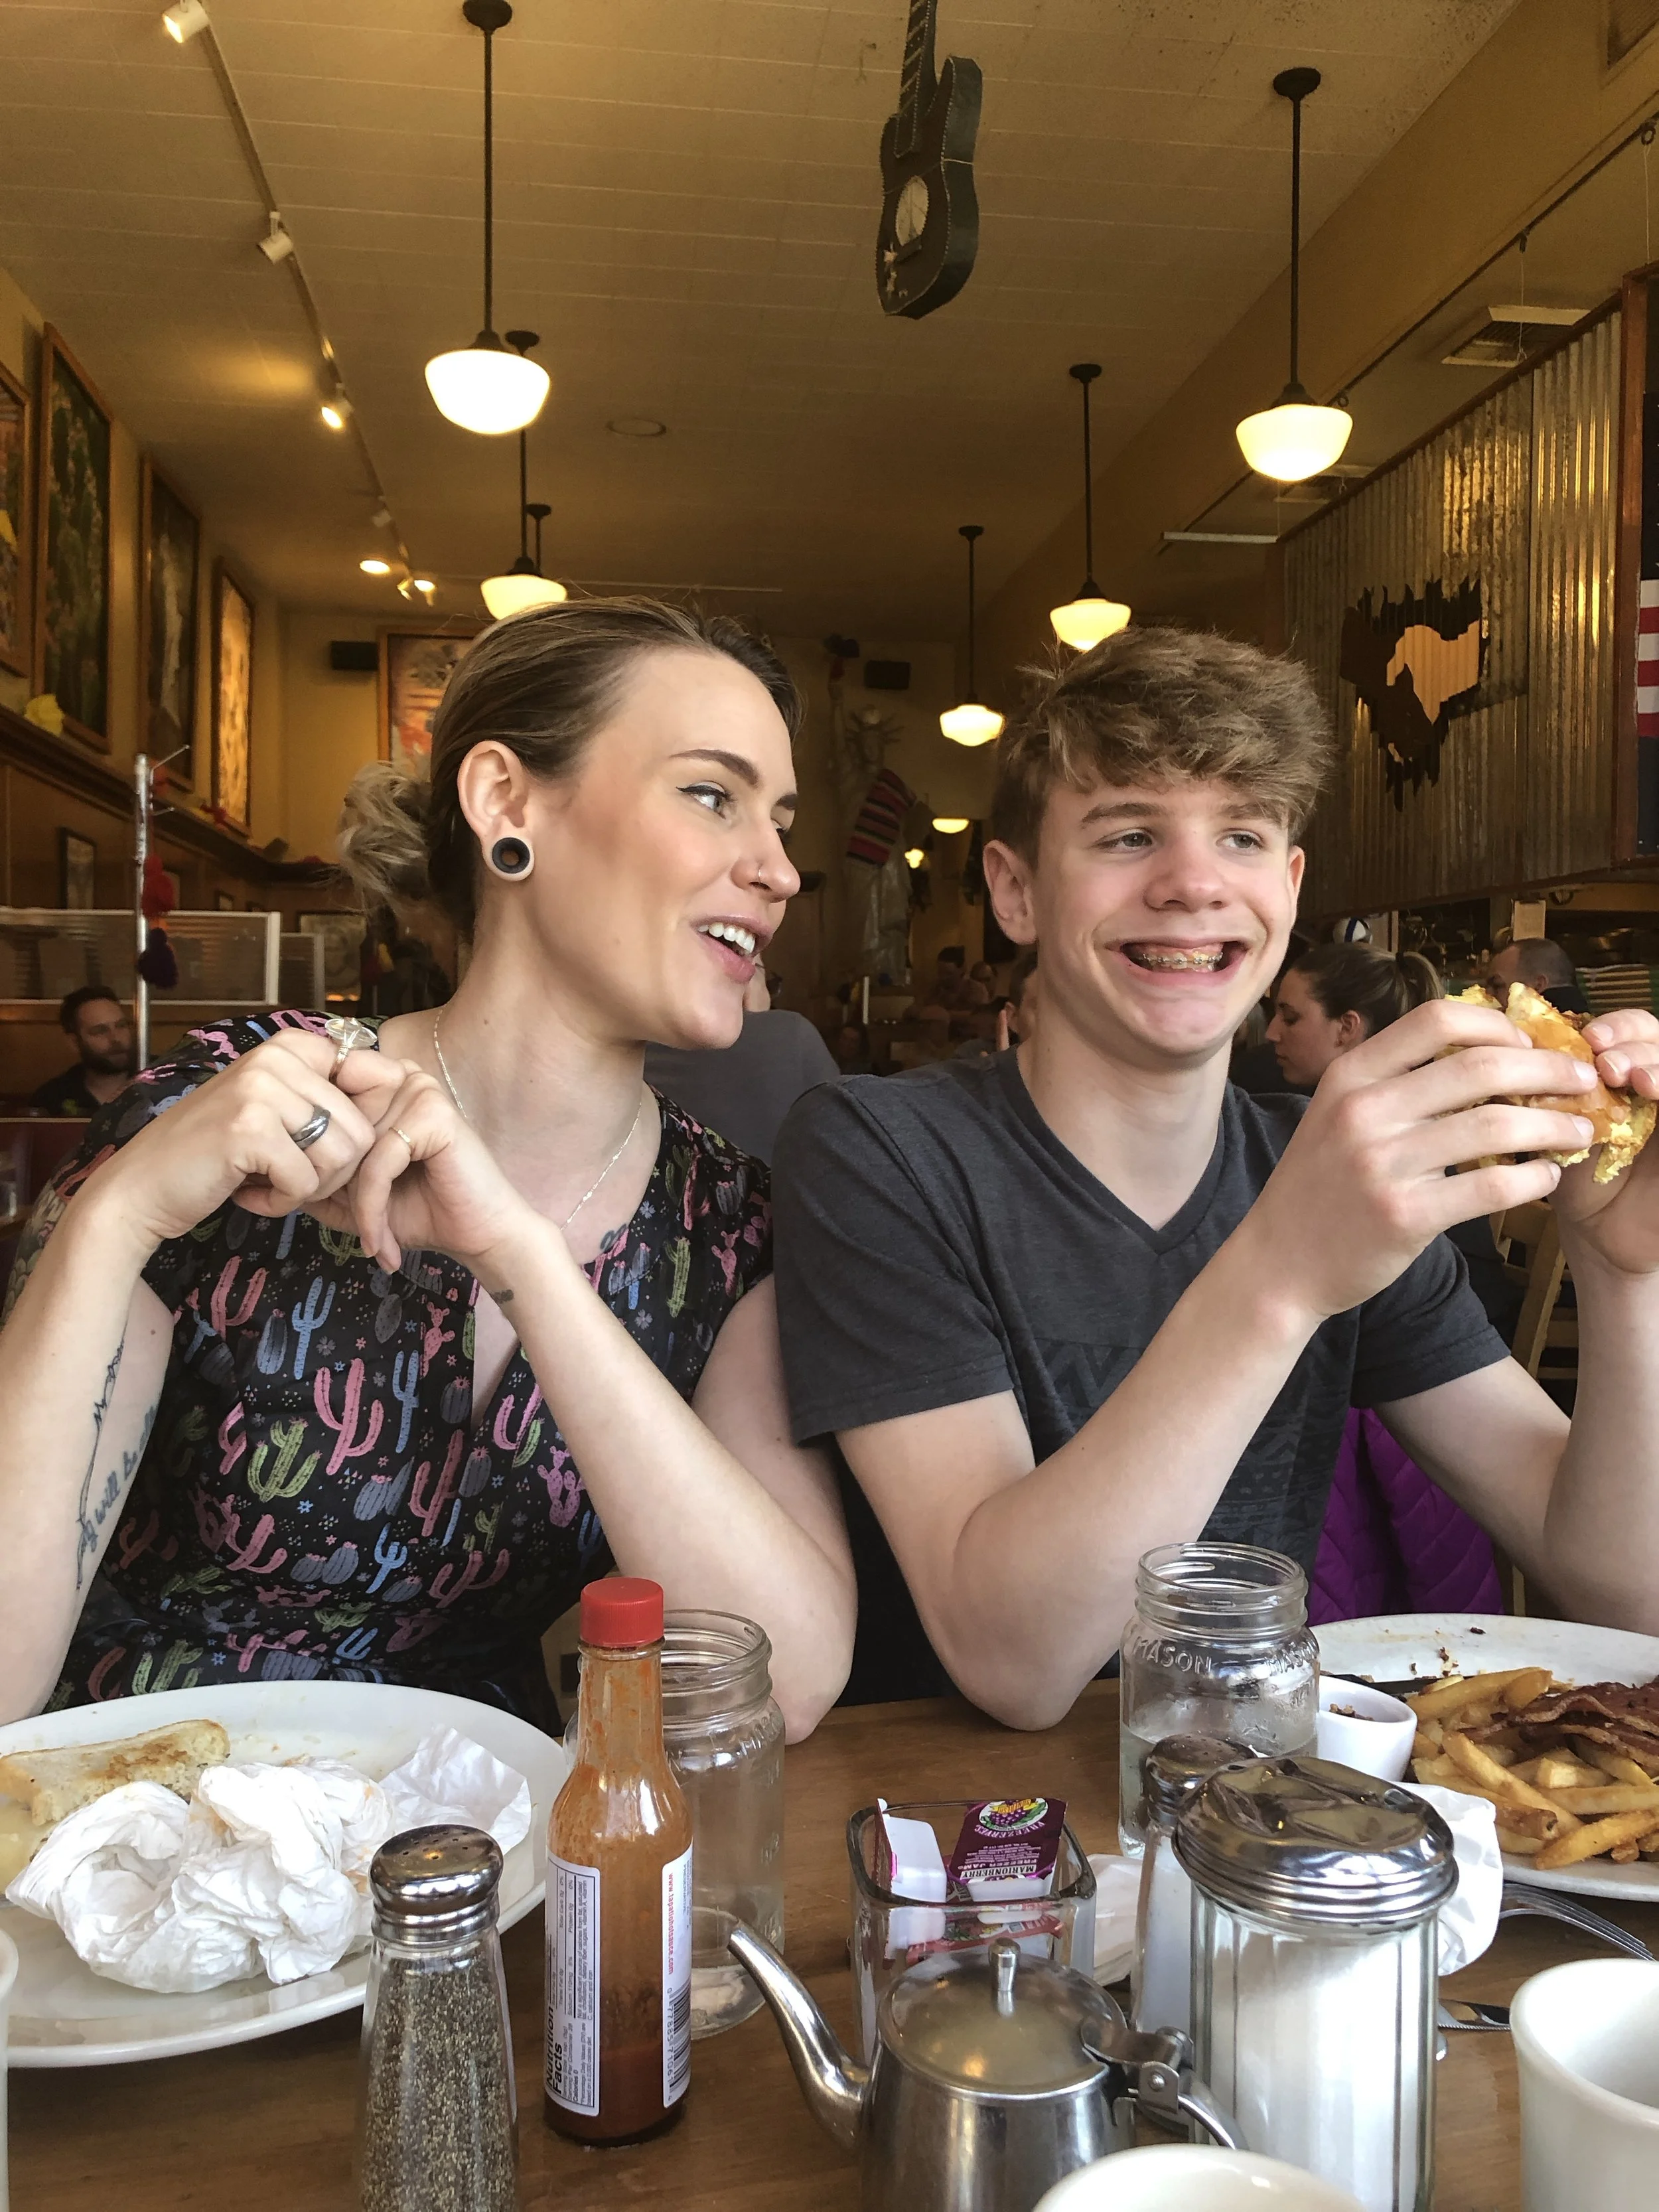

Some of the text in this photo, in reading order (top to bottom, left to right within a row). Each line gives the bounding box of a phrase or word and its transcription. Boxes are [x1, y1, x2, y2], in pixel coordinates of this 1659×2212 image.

[1132, 1635, 1212, 1674] MASON
[962, 1866, 1034, 1878] MARIONBERRY
[553, 2043, 561, 2095] Facts
